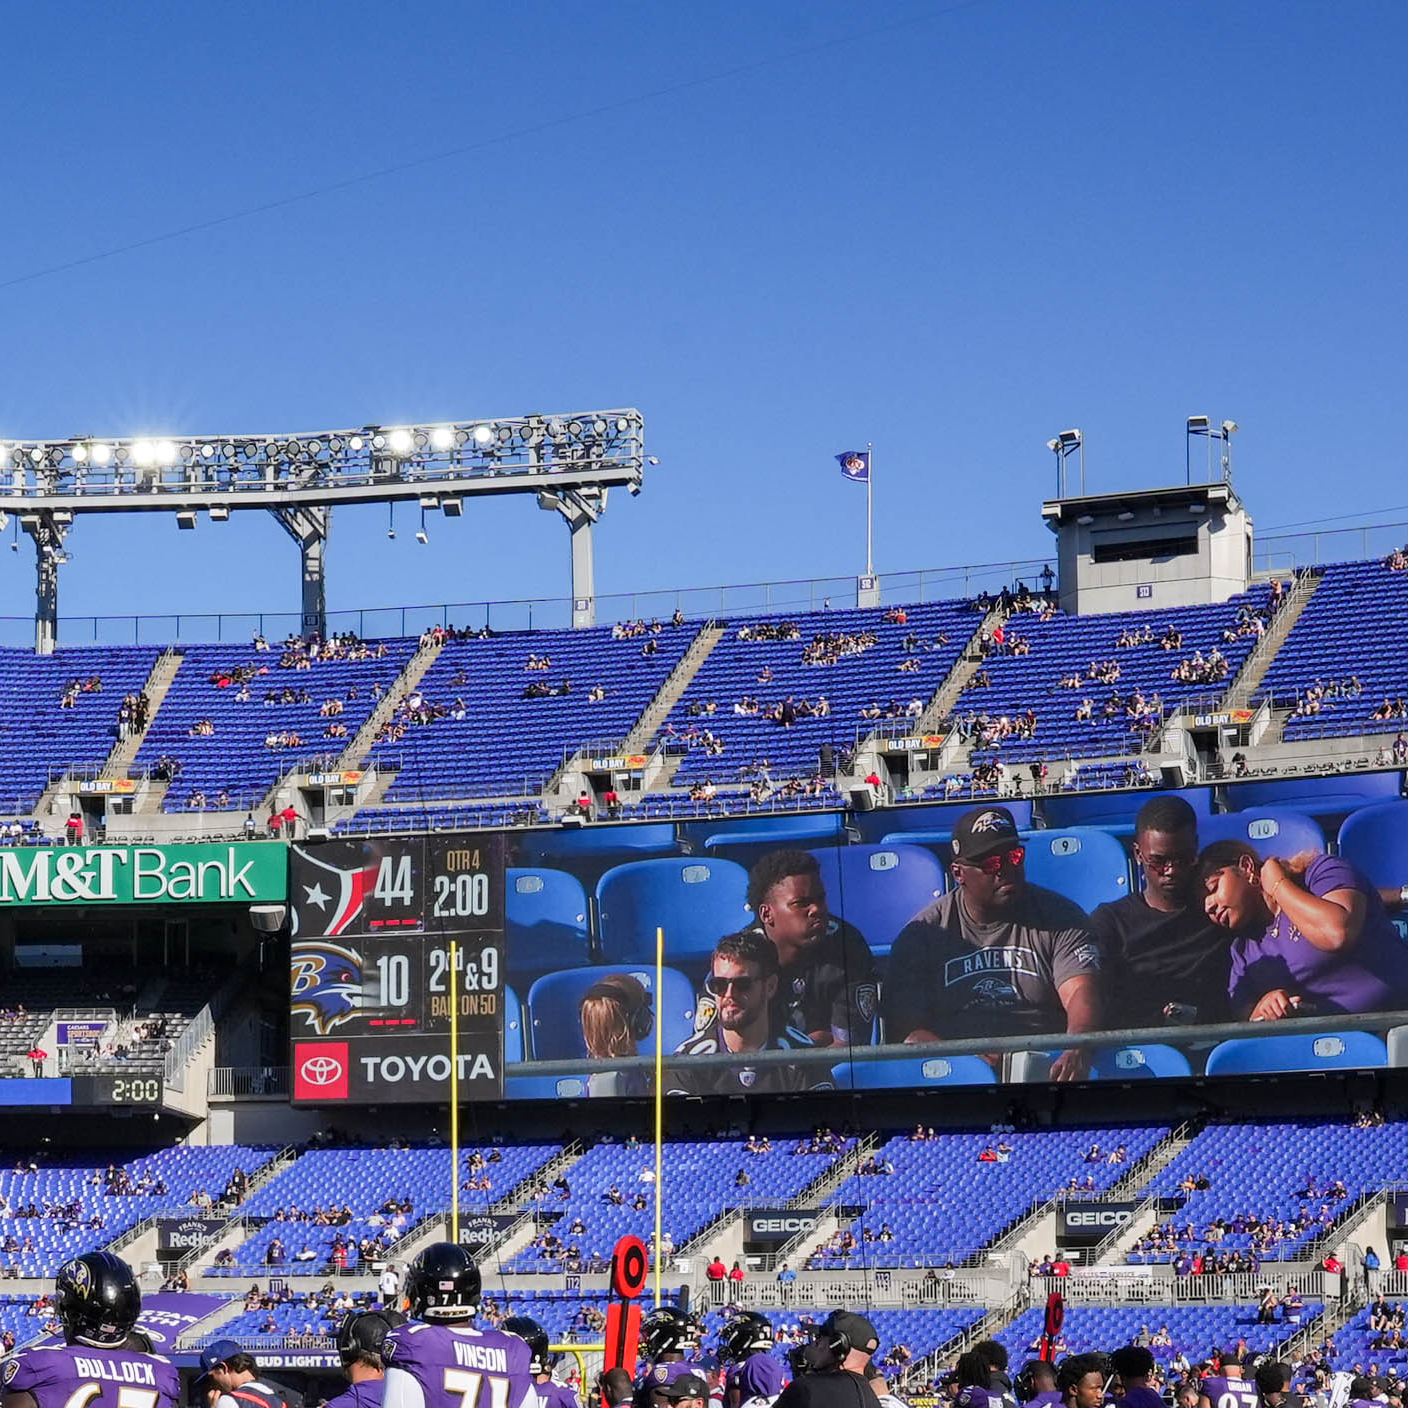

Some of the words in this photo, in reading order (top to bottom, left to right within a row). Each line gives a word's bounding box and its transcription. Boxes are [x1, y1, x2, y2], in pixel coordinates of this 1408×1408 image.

[1195, 715, 1209, 726] OLD
[1210, 713, 1230, 724] BAY
[888, 739, 903, 750] OLD
[903, 738, 922, 749] BAY
[592, 759, 607, 770] OLD
[608, 758, 626, 769] BAY
[80, 781, 95, 791] OLD
[95, 782, 112, 792] BAY
[309, 773, 324, 785] OLD
[325, 773, 340, 784] BAY
[446, 850, 470, 872] QTR
[472, 848, 481, 869] 4
[133, 846, 257, 900] Bank
[374, 855, 413, 906] 44
[433, 873, 488, 917] 2:00
[963, 946, 1025, 974] RAVENS
[376, 955, 409, 1007] 10
[461, 994, 478, 1016] ON
[479, 993, 496, 1015] 50
[360, 1053, 495, 1082] TOYOTA
[112, 1079, 158, 1101] 2:00
[178, 1221, 208, 1232] FRANK'S
[467, 1217, 498, 1229] FRANK'S
[1066, 1211, 1133, 1226] GEICO
[255, 1355, 283, 1368] BUD
[284, 1355, 323, 1368] LIGHT
[453, 1341, 507, 1373] VINSON
[73, 1356, 156, 1387] BULLOCK
